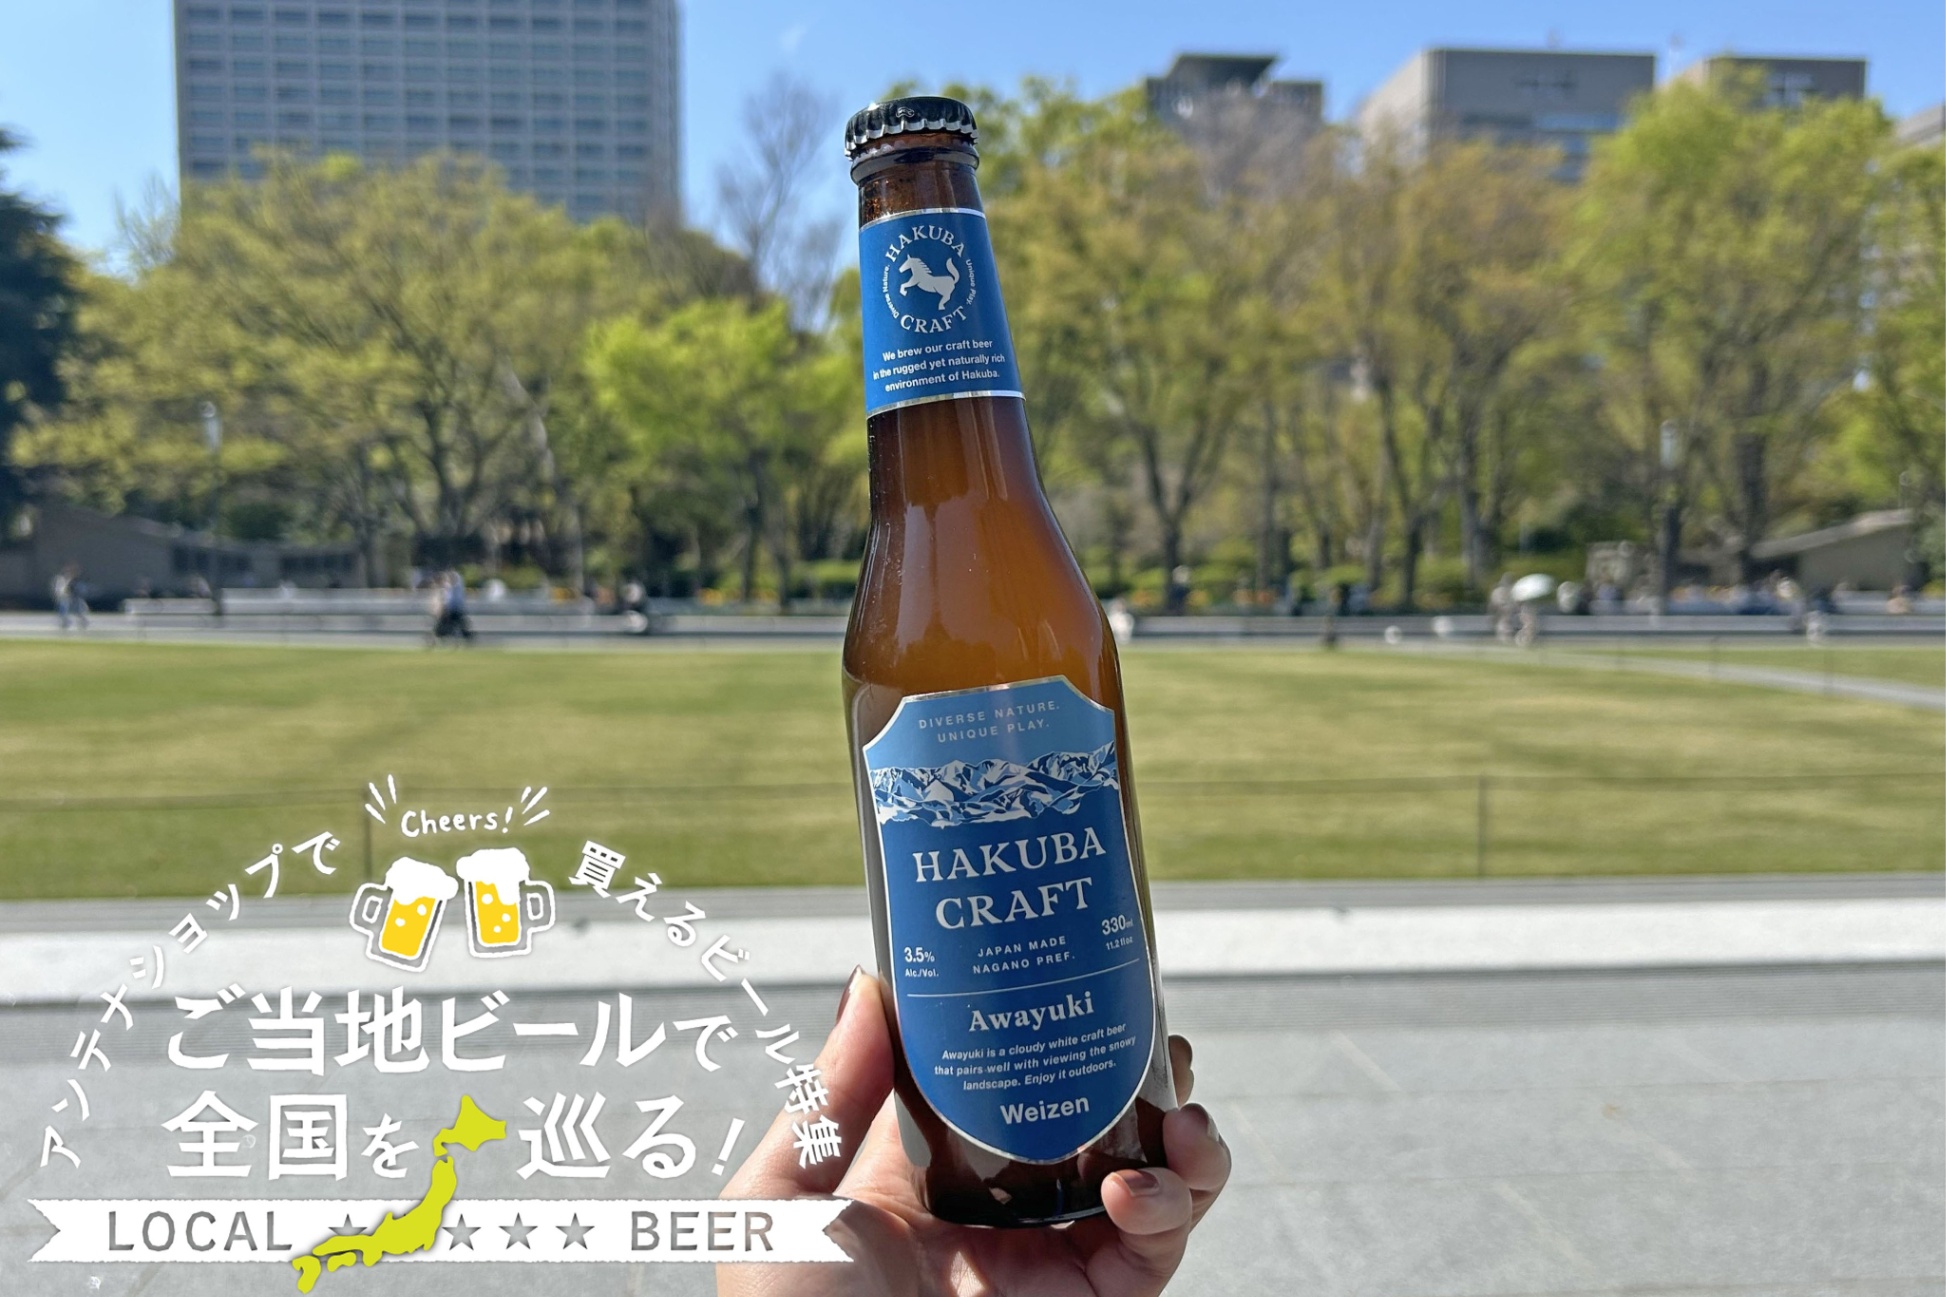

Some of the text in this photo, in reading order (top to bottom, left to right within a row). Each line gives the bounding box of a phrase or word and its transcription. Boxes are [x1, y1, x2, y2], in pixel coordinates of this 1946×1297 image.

[885, 225, 964, 262] HAKUBA
[900, 306, 967, 333] CRAFT
[882, 340, 993, 361] We brew our craft beer
[873, 353, 1005, 380] in the rugged yet naturally rich
[885, 369, 1000, 392] environment of Hakuba.
[919, 701, 1060, 729] DIVERSE NATURE.
[937, 718, 1050, 743] UNIQUE PLAY.
[912, 827, 1106, 883] HAKUBA
[936, 877, 1093, 929] CRAFT
[904, 946, 935, 963] 3.5%
[977, 936, 1066, 957] JAPAN MADE
[905, 968, 939, 977] Alc./Vol.
[972, 952, 1075, 974] NAGANO PREF.
[968, 991, 1094, 1032] Awayuki
[942, 1049, 984, 1061] Awayuki
[987, 1048, 996, 1058] is
[1009, 1042, 1045, 1056] cloudy
[1049, 1037, 1078, 1050] white
[1081, 1030, 1104, 1043] craft
[1106, 1023, 1126, 1036] beer
[934, 1035, 1136, 1077] that pairs well with viewing the snowy
[963, 1061, 1117, 1091] landscape. Enjoy it outdoors.
[1000, 1096, 1090, 1125] Weizen
